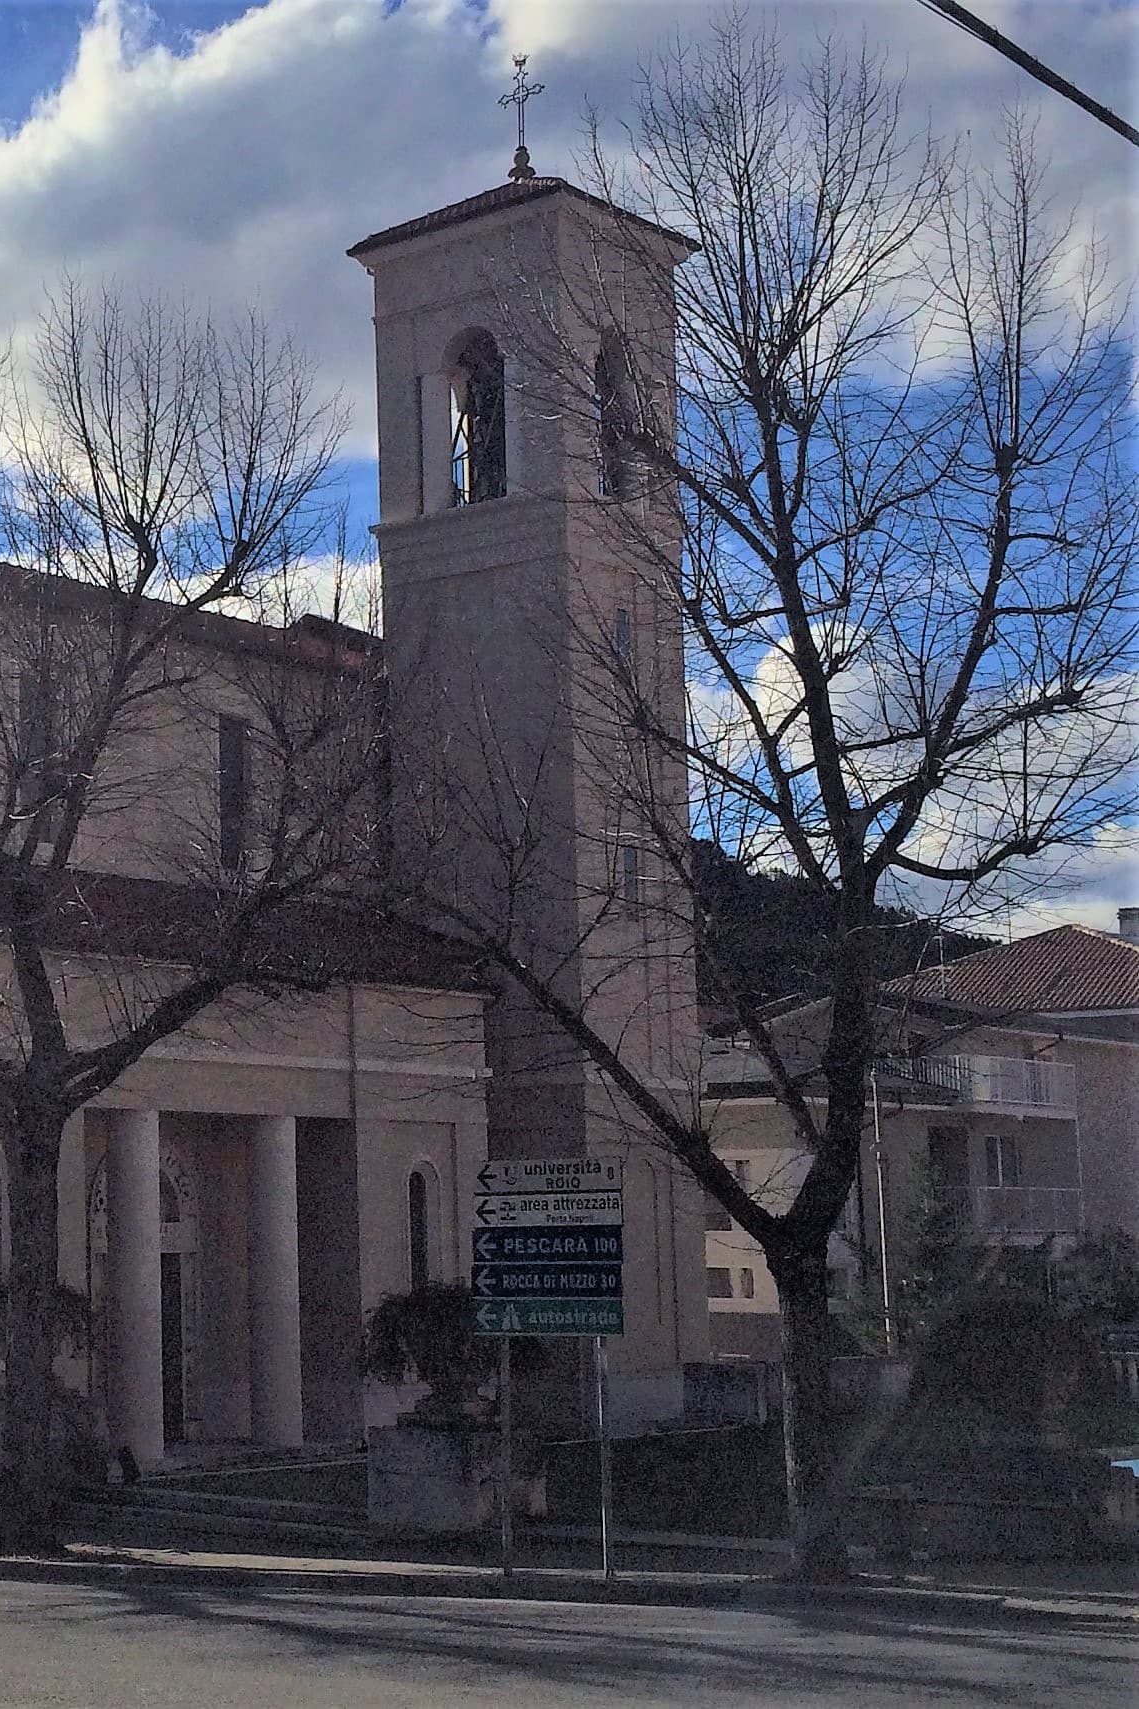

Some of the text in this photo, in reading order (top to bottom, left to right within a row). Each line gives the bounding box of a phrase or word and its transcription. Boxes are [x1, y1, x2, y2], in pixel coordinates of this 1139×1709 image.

[545, 1177, 581, 1189] ROIO
[521, 1197, 620, 1212] area attrezzata
[503, 1237, 617, 1254] PESCARA 100
[502, 1274, 540, 1289] ROCCA
